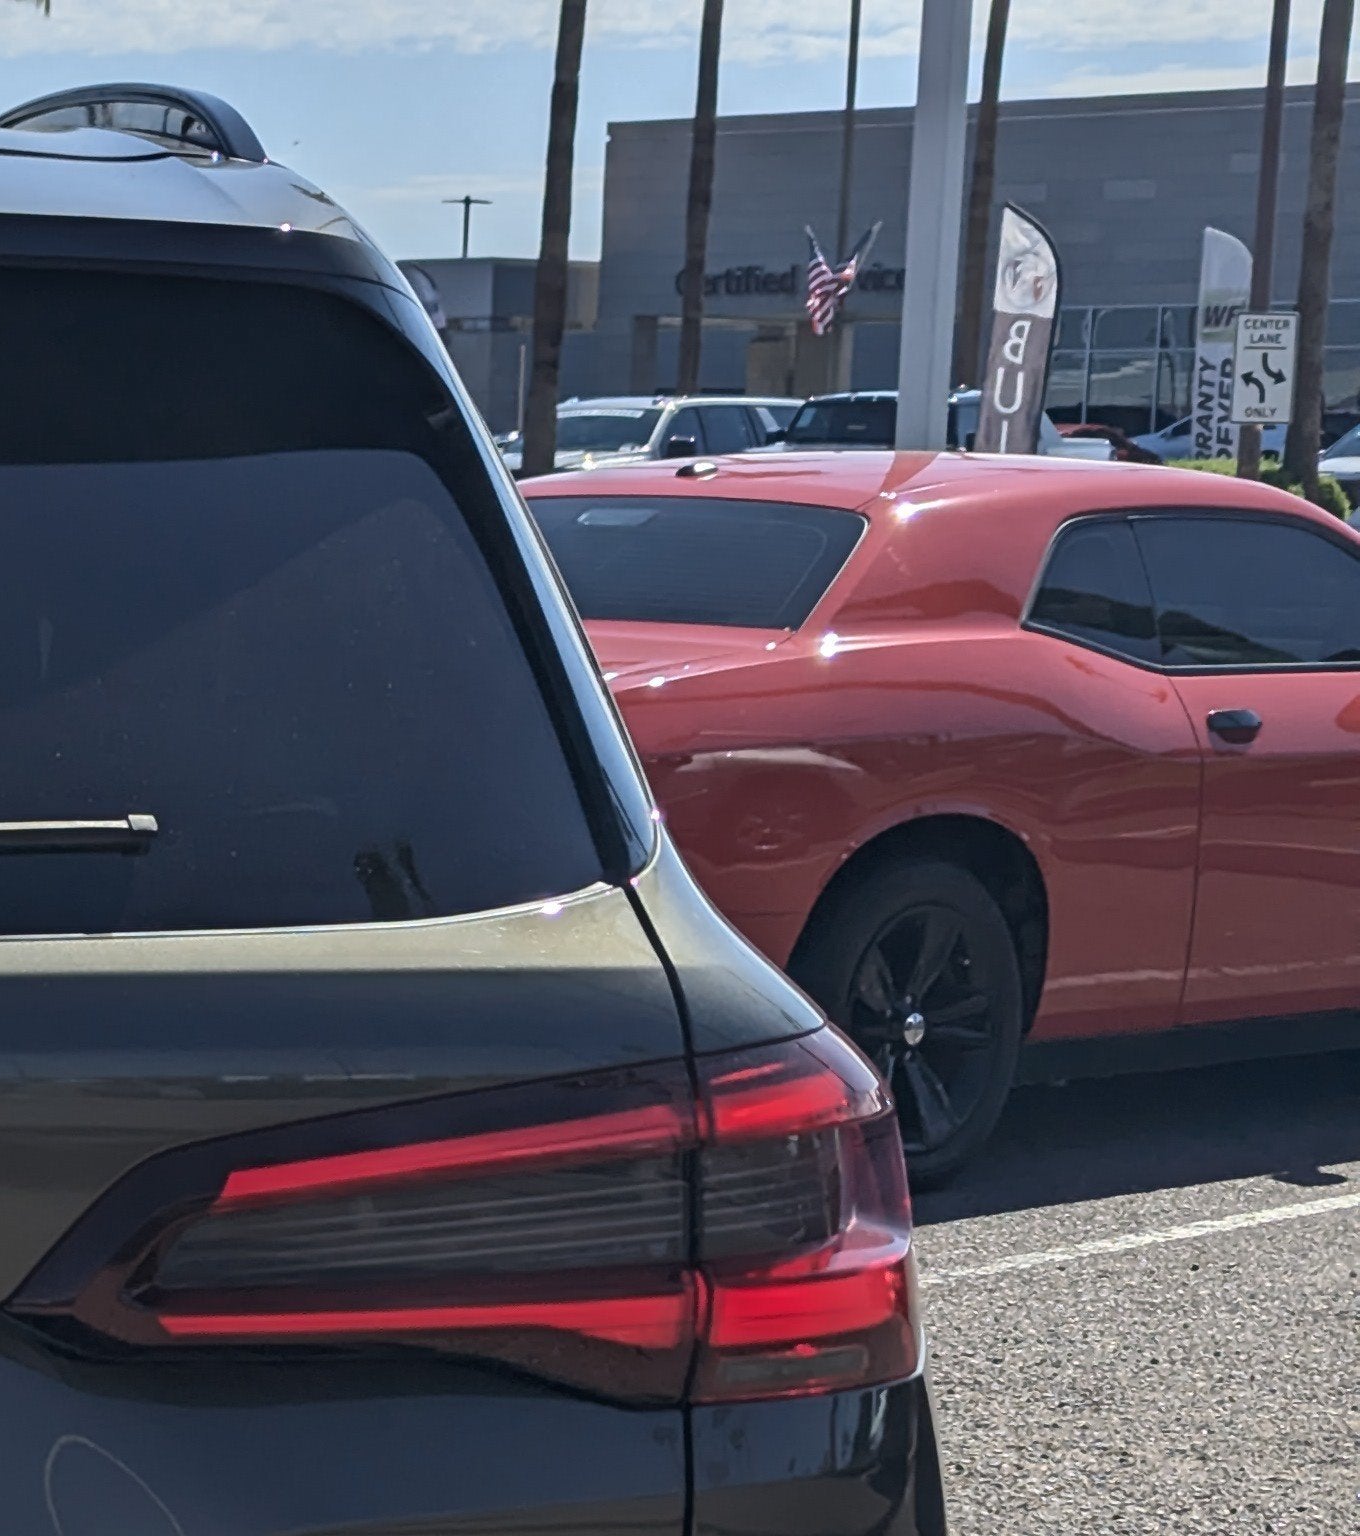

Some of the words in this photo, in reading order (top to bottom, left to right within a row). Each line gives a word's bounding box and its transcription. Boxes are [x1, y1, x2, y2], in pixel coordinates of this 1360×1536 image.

[1243, 318, 1290, 330] CENTER
[1249, 333, 1282, 344] LANE
[1244, 406, 1278, 418] ONLY
